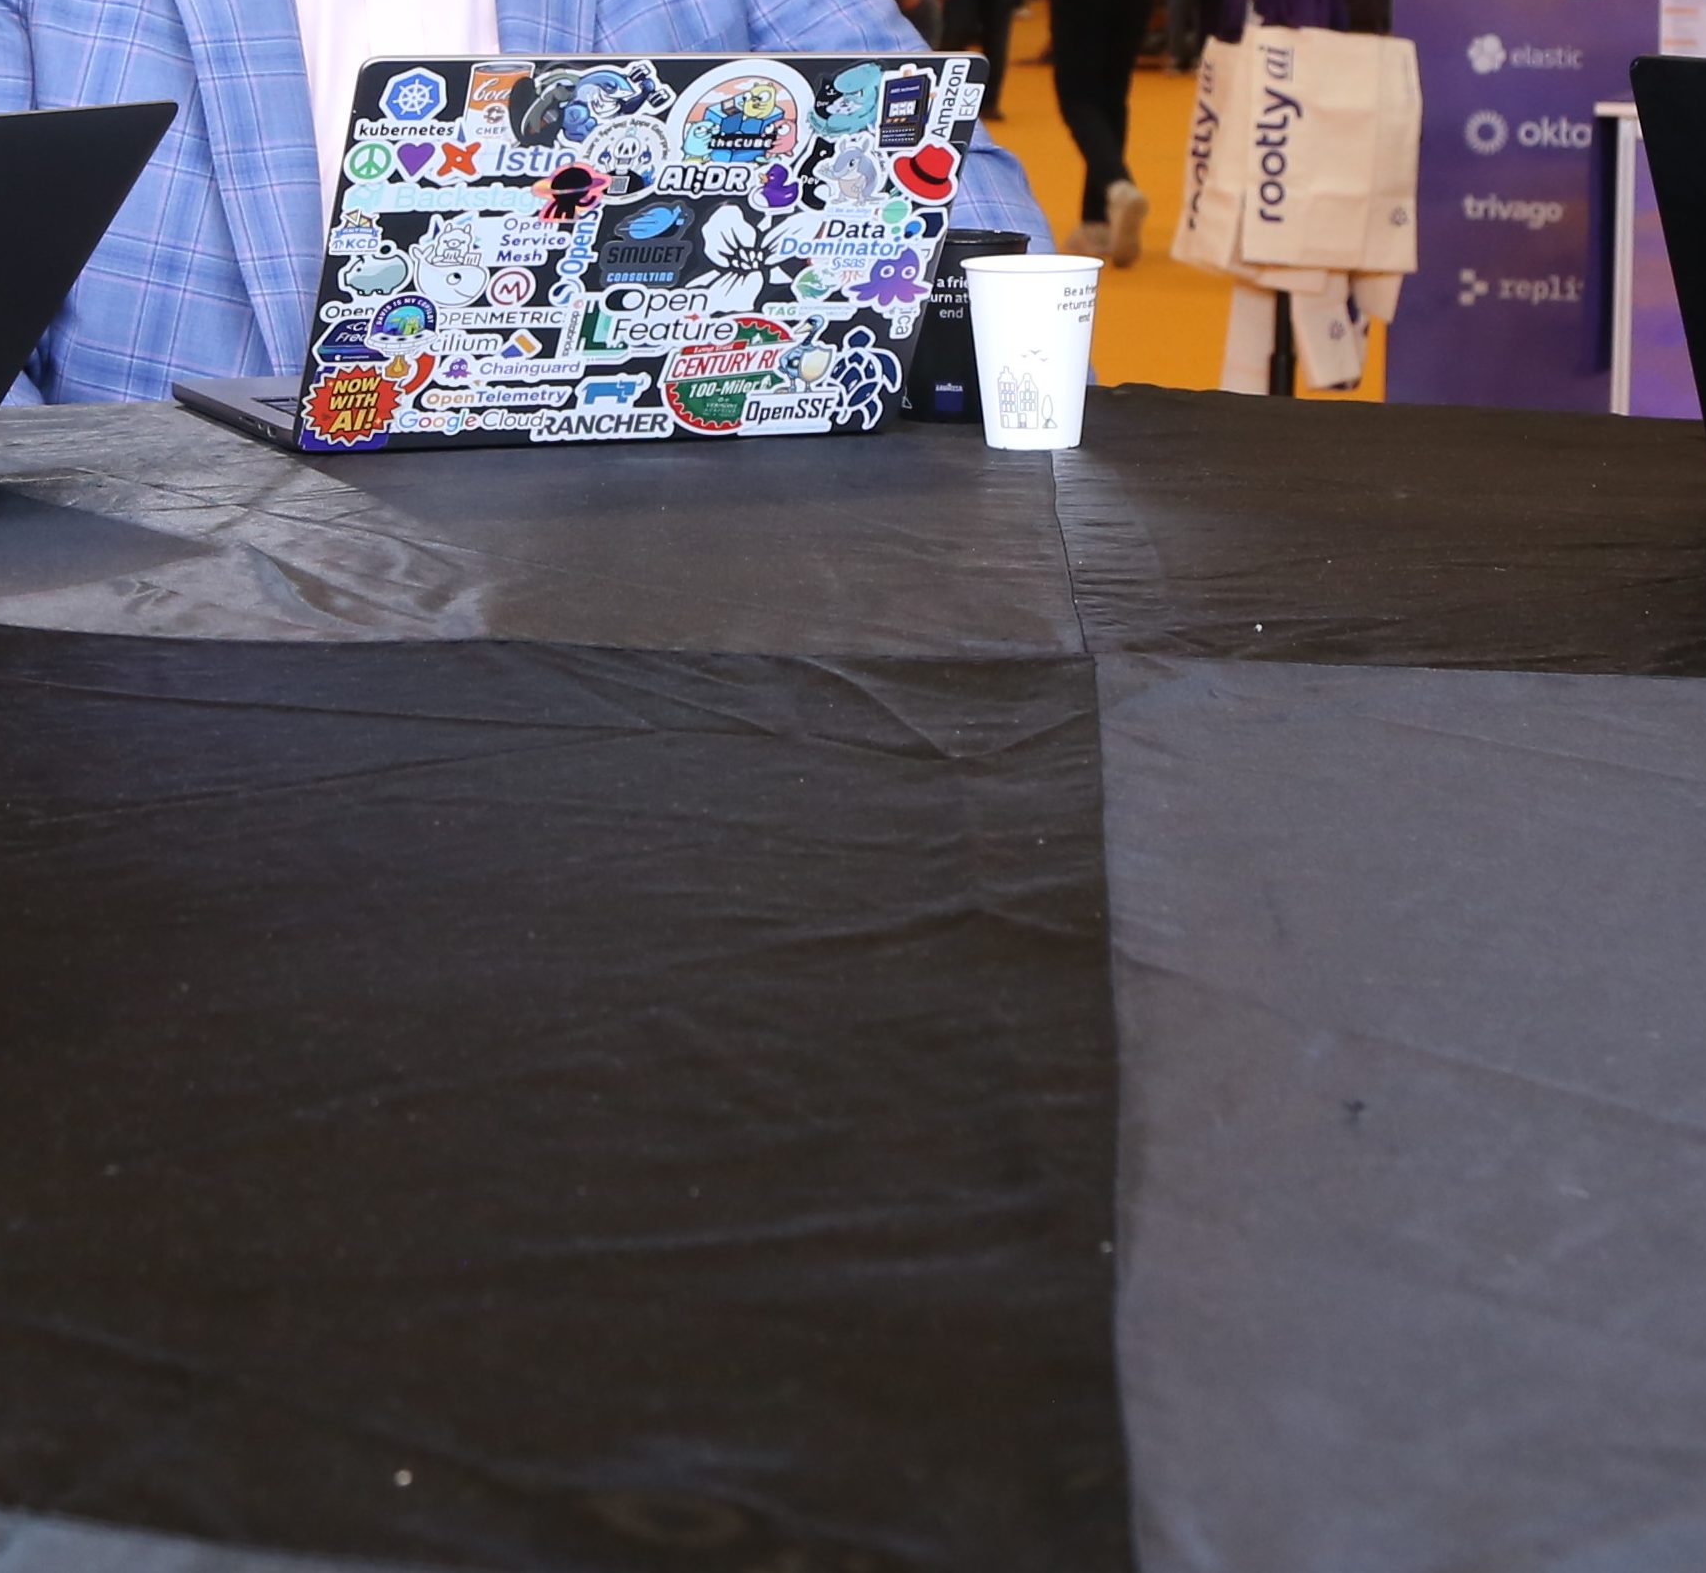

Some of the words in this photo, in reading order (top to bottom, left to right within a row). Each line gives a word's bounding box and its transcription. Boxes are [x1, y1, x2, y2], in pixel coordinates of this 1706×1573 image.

[1258, 45, 1295, 81] ai
[1510, 44, 1584, 70] elastic
[931, 64, 967, 139] Amazon
[958, 87, 981, 118] EKS
[359, 124, 455, 137] kubernetes
[475, 127, 506, 135] CHEF
[710, 137, 774, 149] theCUBE
[496, 144, 576, 172] Istio
[1255, 85, 1304, 224] rootly
[659, 164, 749, 193] AI;DR
[396, 184, 545, 213] Backstag
[1462, 194, 1565, 230] trivago
[503, 217, 554, 234] Open
[826, 219, 886, 239] Data
[345, 238, 379, 249] KCD
[500, 235, 567, 247] Service
[779, 237, 906, 257] Dominator
[496, 250, 543, 263] Mesh
[606, 246, 686, 265] SMUGET
[606, 271, 675, 284] CONSULTING
[954, 292, 968, 304] at
[1063, 287, 1077, 297] Be
[605, 288, 709, 318] Open
[766, 305, 797, 316] TAG
[939, 306, 964, 319] end
[440, 310, 565, 326] OPENMETRIC
[613, 317, 734, 342] Feature
[429, 333, 499, 353] cilium
[479, 360, 581, 377] Chainguard
[671, 350, 759, 379] CENTURY
[332, 376, 381, 394] NOW
[330, 393, 379, 411] WITH
[426, 388, 569, 408] OpenTelemetry
[328, 408, 377, 434] AI!
[744, 397, 836, 425] OpenSSF
[399, 410, 477, 433] Google
[482, 411, 545, 428] Cloud
[536, 410, 669, 437] RANCHER
